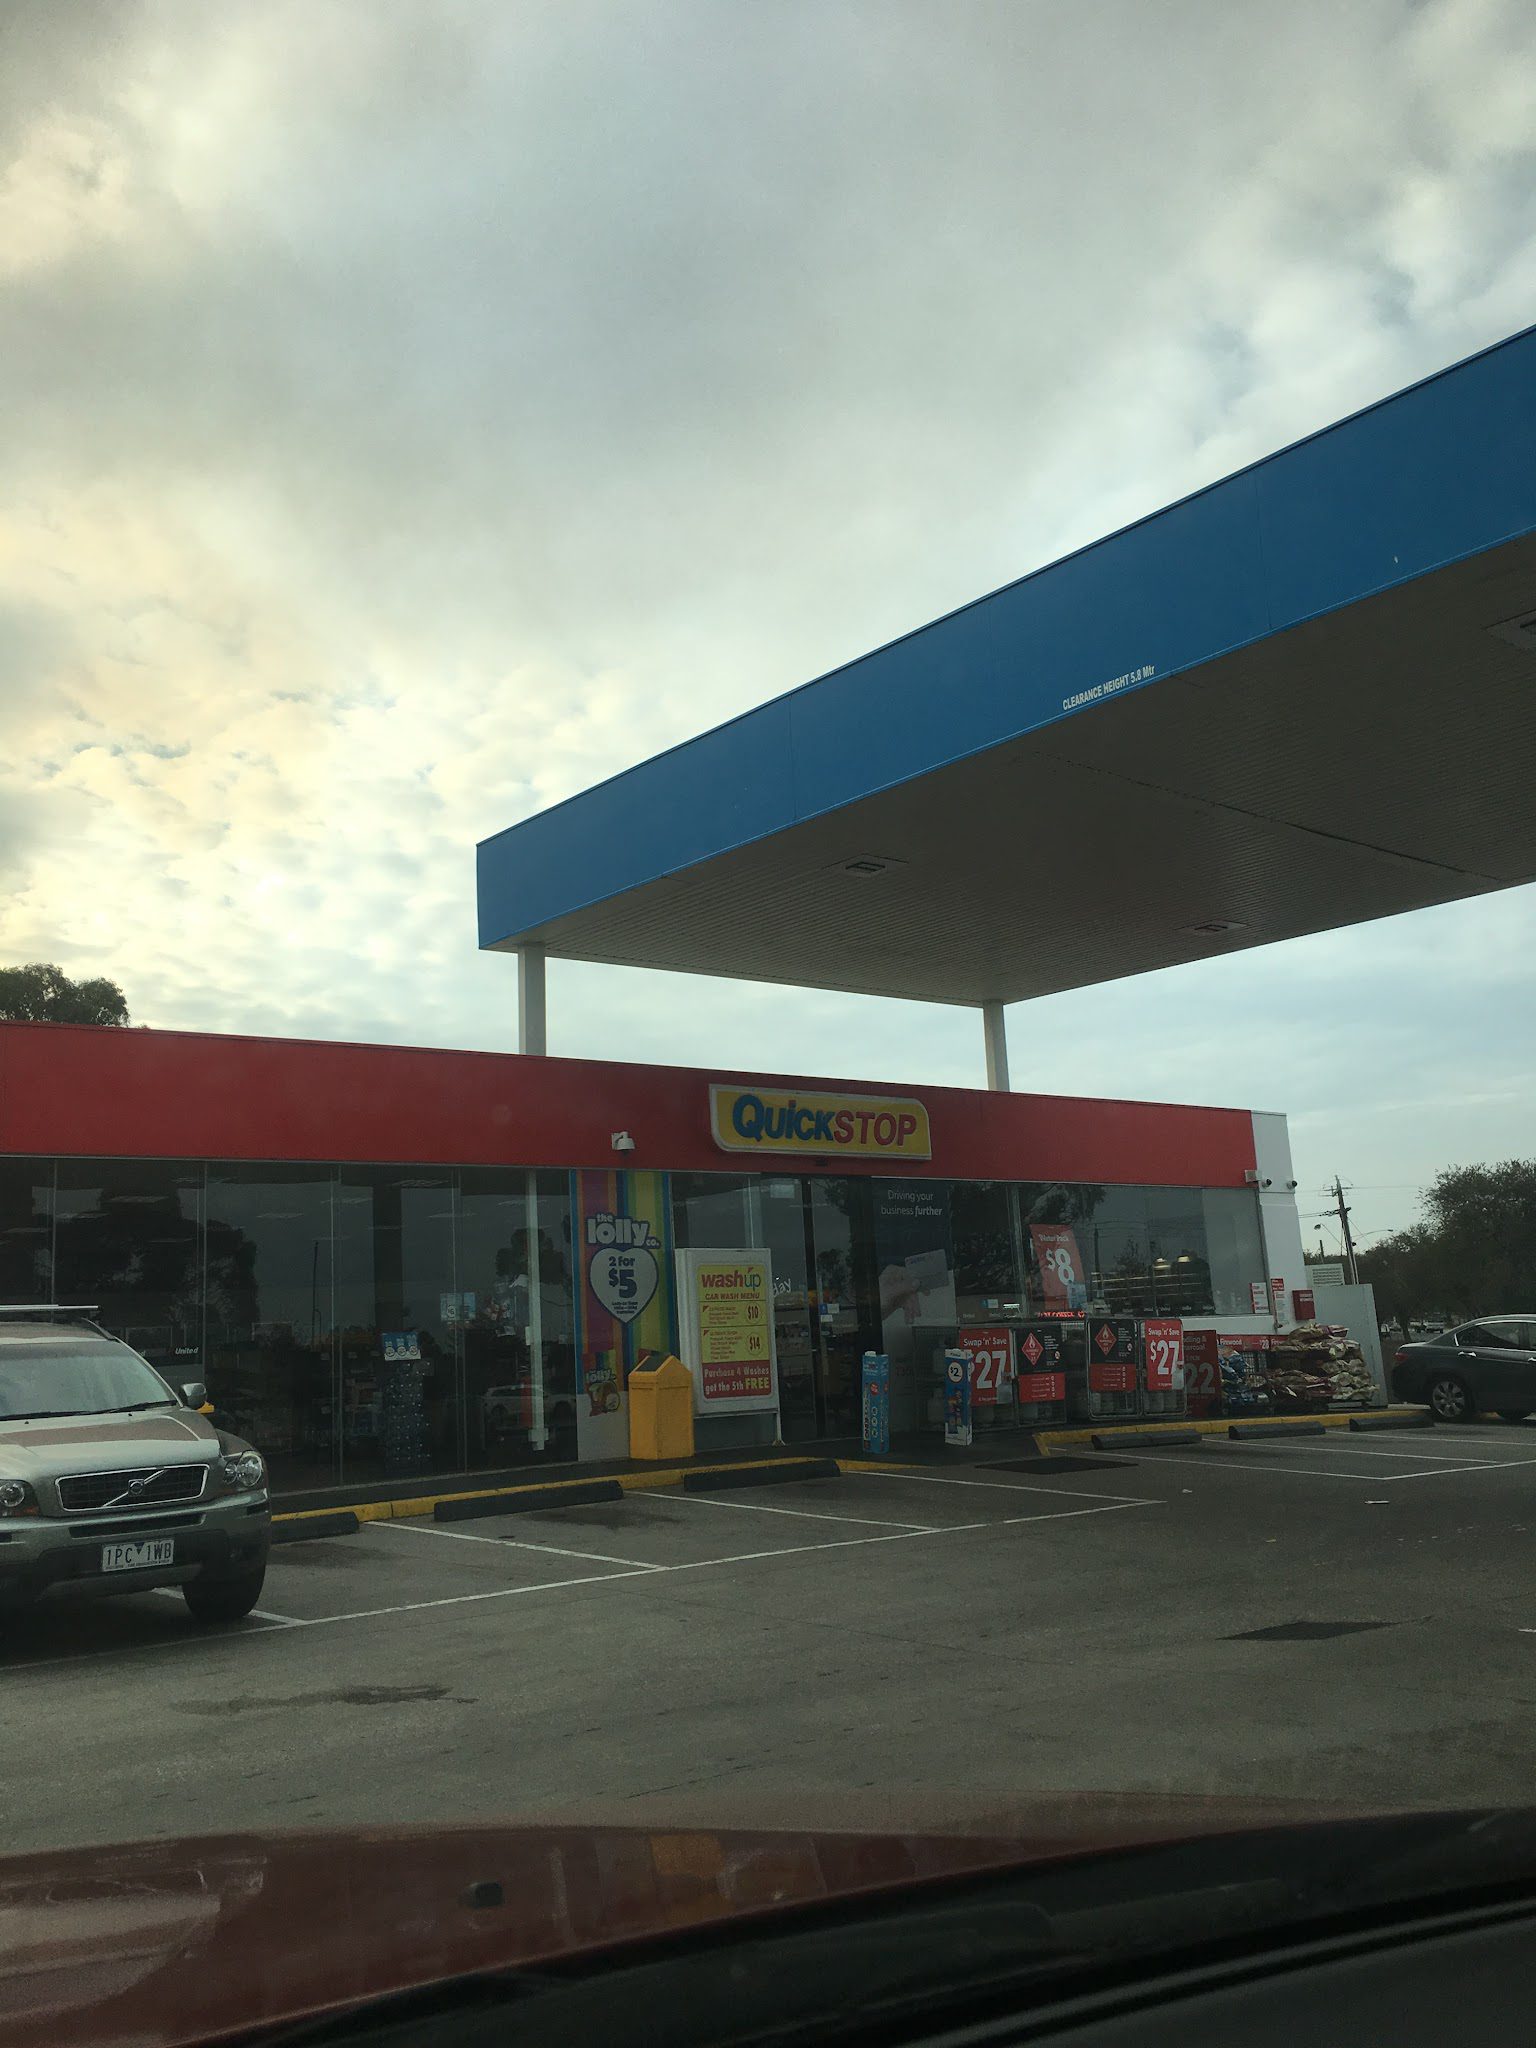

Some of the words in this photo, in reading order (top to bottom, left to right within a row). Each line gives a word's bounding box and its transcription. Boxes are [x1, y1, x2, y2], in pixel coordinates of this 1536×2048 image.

[1063, 685, 1102, 710] CLEARANCE
[1103, 674, 1130, 695] HEIGHT
[1130, 669, 1142, 684] 5.8
[1142, 665, 1155, 678] Mtr
[887, 1189, 915, 1203] Driving
[916, 1192, 934, 1202] your
[881, 1204, 914, 1215] business
[597, 1213, 614, 1223] the
[587, 1218, 648, 1248] lolly
[645, 1238, 660, 1247] co.
[608, 1256, 617, 1267] 2
[618, 1255, 636, 1267] for
[1045, 1247, 1075, 1286] $8
[608, 1267, 638, 1299] $5
[701, 1267, 762, 1292] washup
[704, 1293, 720, 1301] CAR
[740, 1292, 760, 1300] MENU
[747, 1304, 759, 1321] $10
[1148, 1327, 1161, 1336] Swap
[1168, 1327, 1180, 1336] Save
[749, 1336, 761, 1351] $14
[963, 1338, 982, 1347] Swap
[992, 1336, 1007, 1345] Save
[175, 1347, 199, 1355] United
[1150, 1339, 1180, 1375] $27
[704, 1367, 735, 1378] Purchase
[736, 1367, 742, 1377] 4
[743, 1366, 770, 1377] Washes
[950, 1366, 960, 1377] $2
[975, 1350, 1007, 1389] 27
[705, 1383, 717, 1395] get
[718, 1381, 731, 1392] the
[732, 1380, 744, 1391] 5th
[745, 1376, 770, 1389] FREE
[106, 1547, 133, 1566] 1PC
[147, 1542, 172, 1561] 1WB
